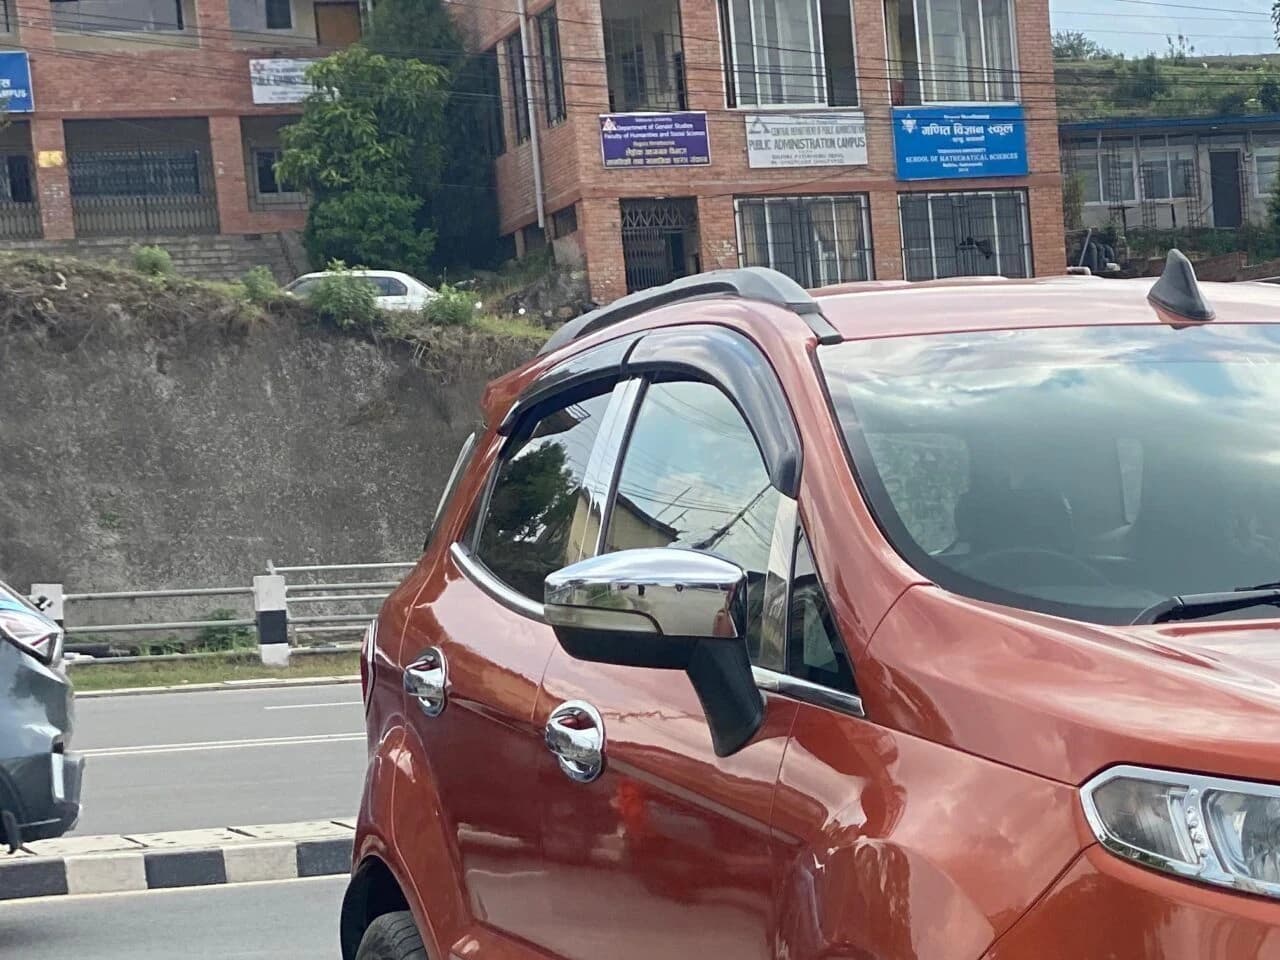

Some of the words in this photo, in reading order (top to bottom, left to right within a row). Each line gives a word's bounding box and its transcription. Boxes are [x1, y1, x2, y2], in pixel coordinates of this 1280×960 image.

[749, 140, 772, 151] PUBLIC
[774, 138, 836, 150] ADMINISTRATION
[837, 137, 866, 149] CAMPUS
